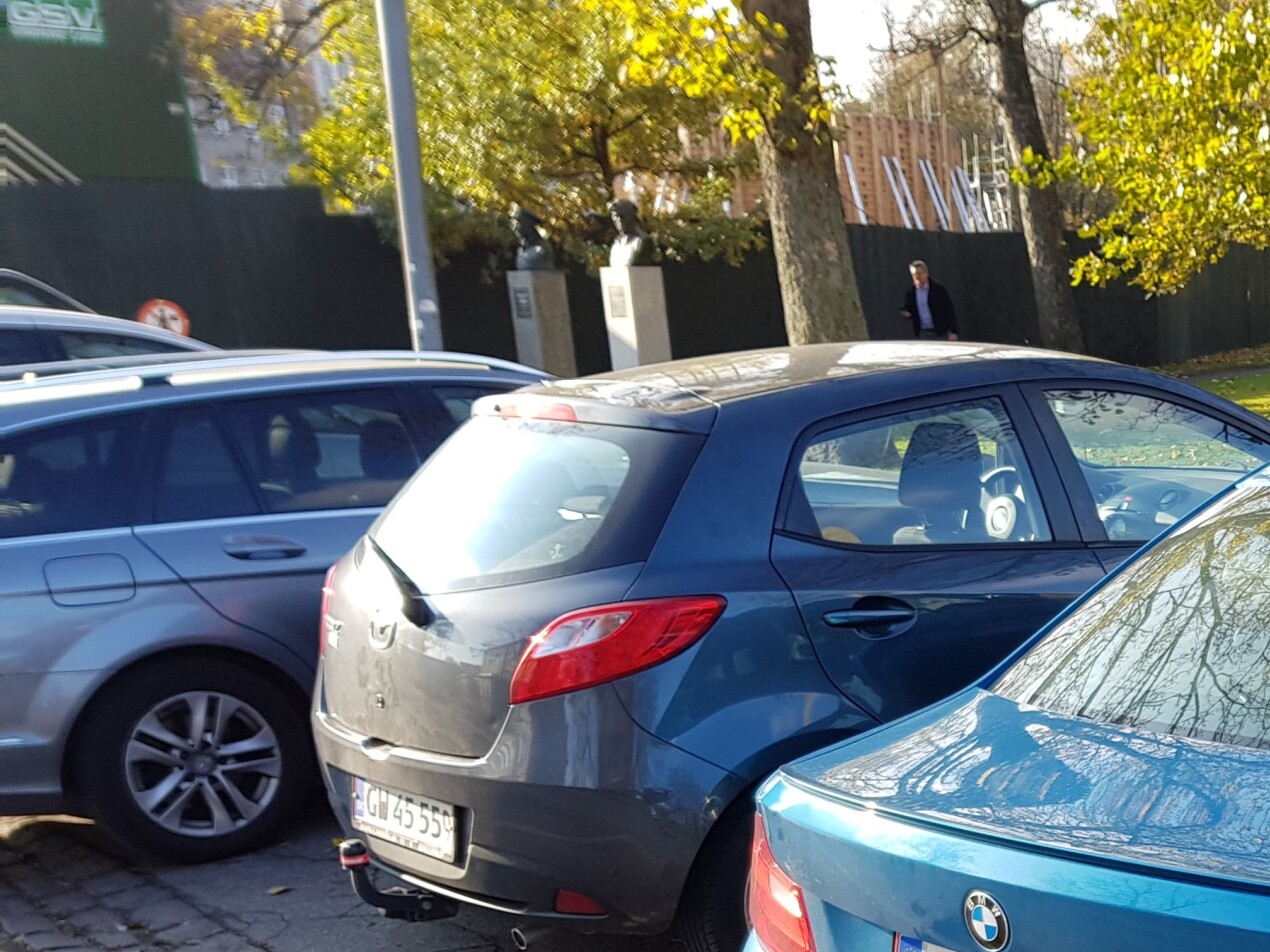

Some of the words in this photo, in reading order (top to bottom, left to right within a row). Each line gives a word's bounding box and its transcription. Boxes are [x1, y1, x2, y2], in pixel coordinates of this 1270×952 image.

[8, 0, 96, 30] GSV
[393, 794, 414, 829] 45
[966, 894, 1002, 917] BMW
